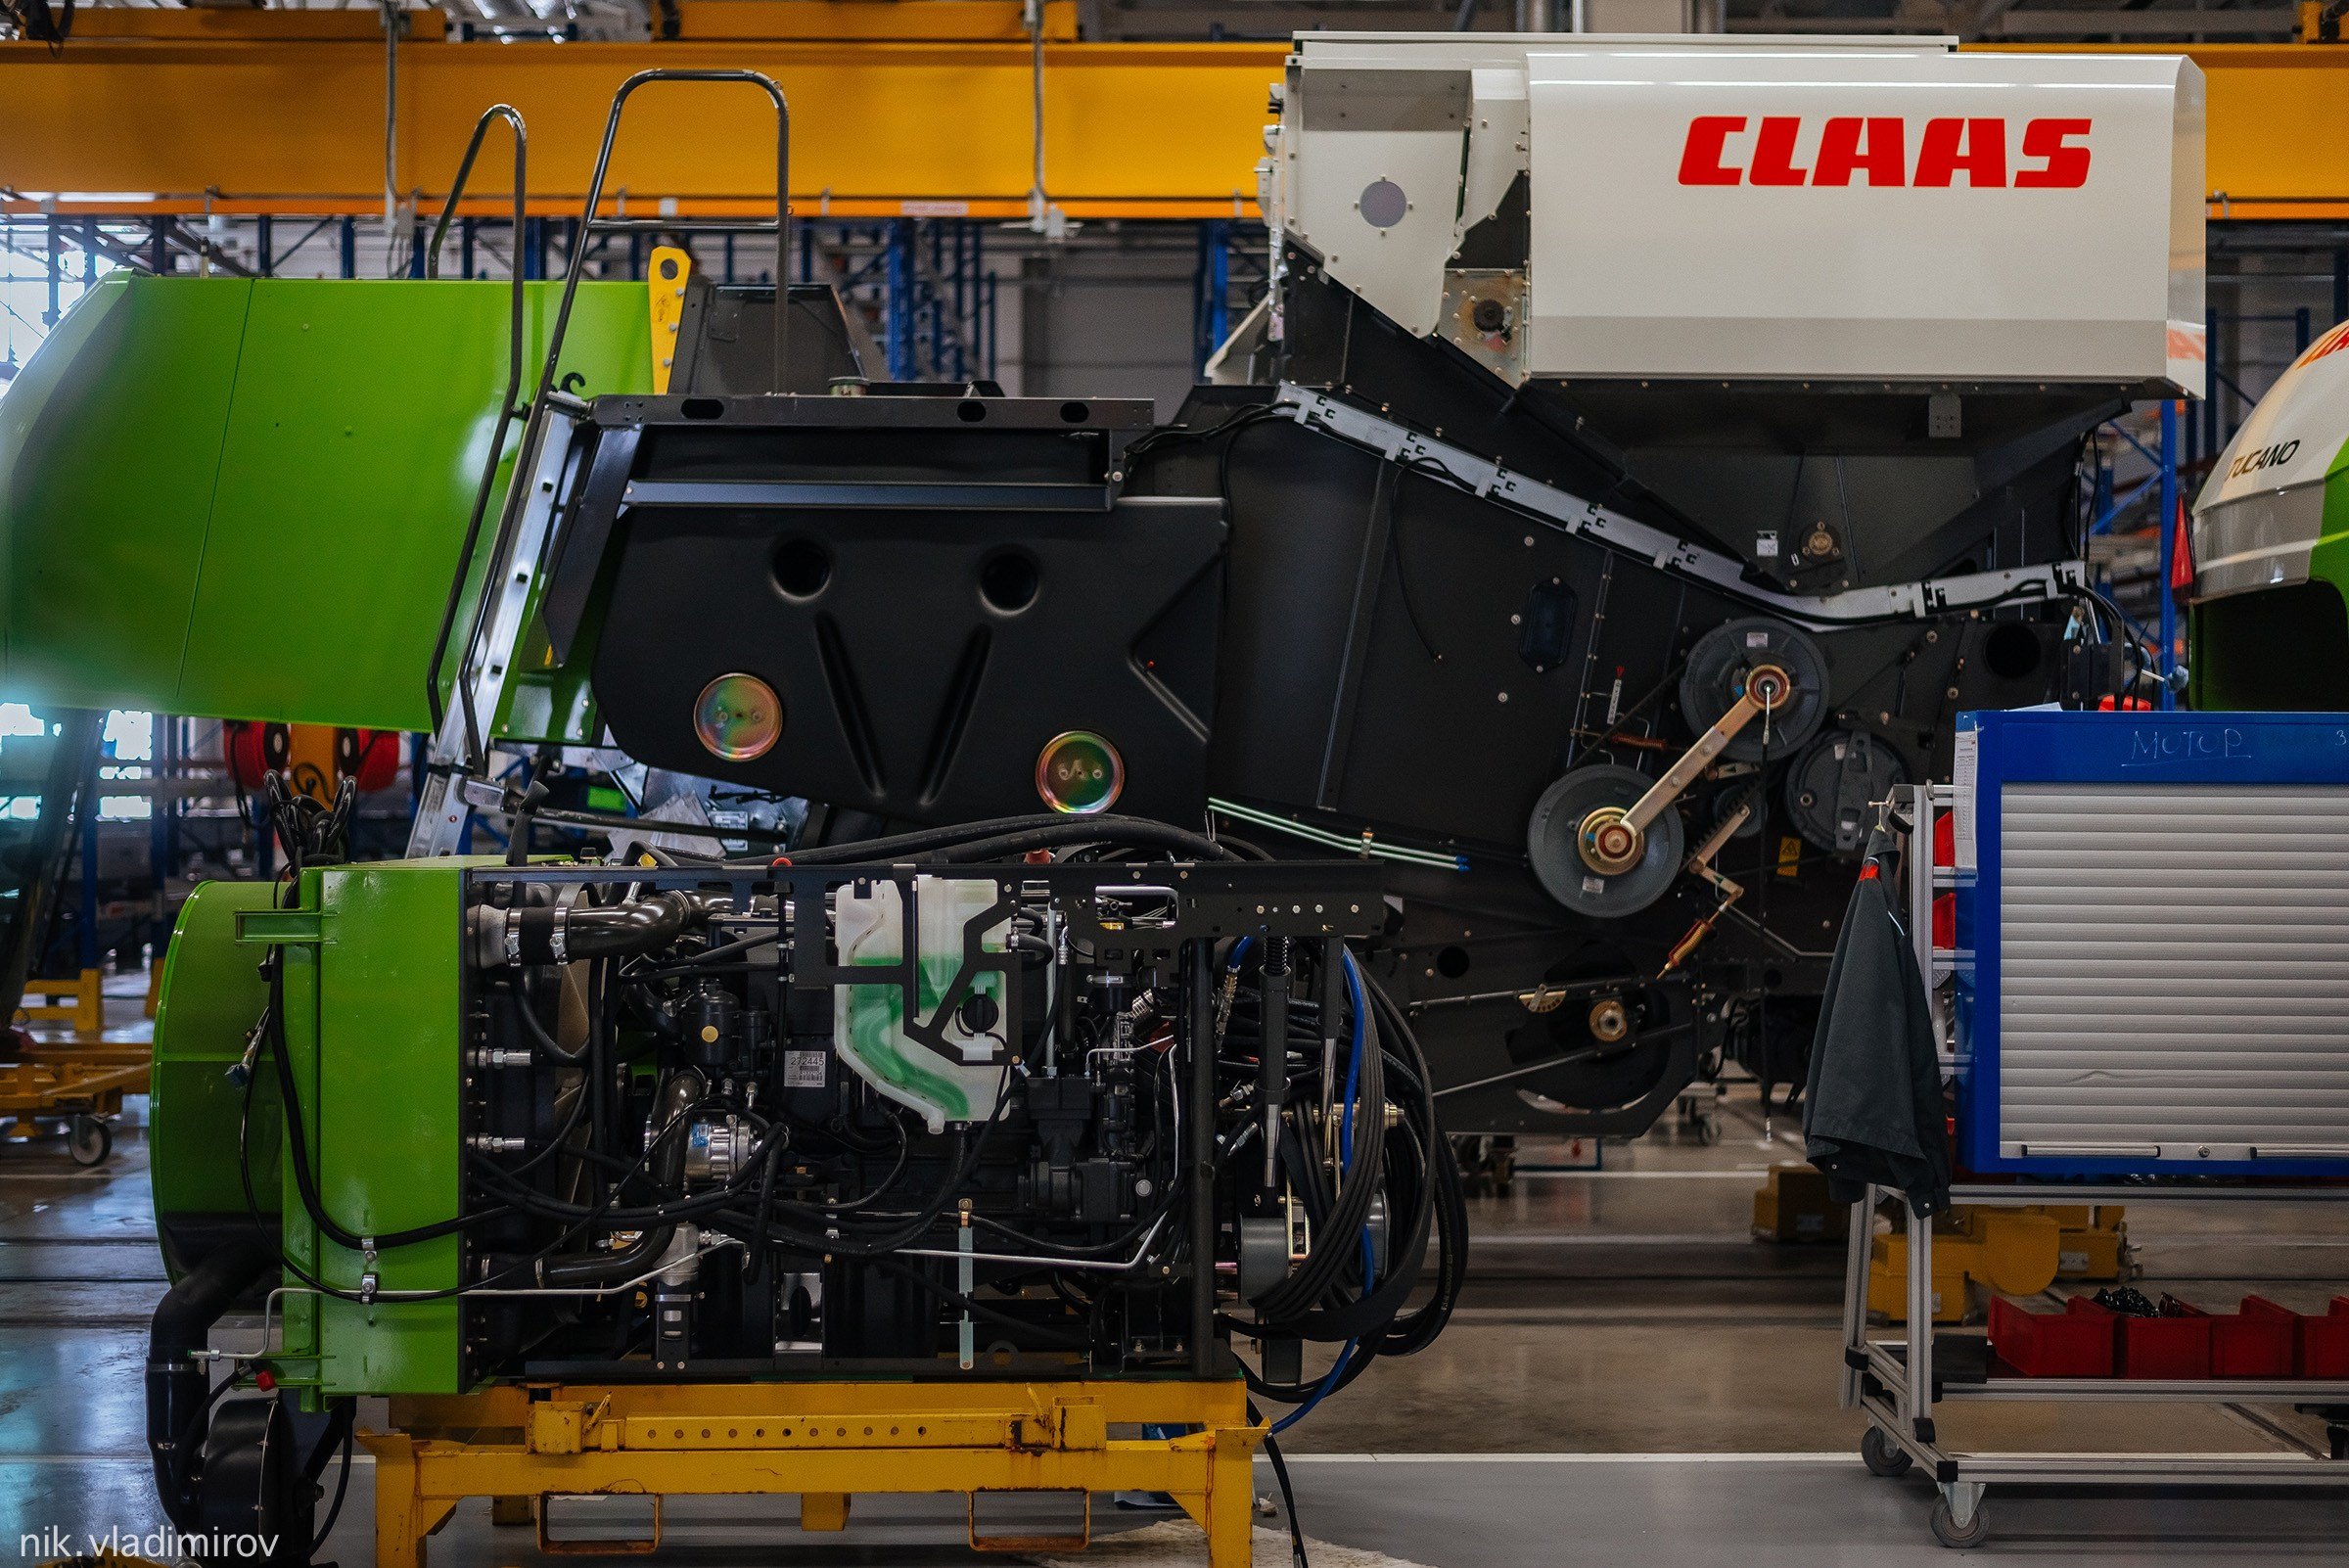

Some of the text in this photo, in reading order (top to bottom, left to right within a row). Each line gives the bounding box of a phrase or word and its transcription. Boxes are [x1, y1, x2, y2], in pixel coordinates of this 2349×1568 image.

[1678, 115, 2093, 188] CLAAS
[2225, 438, 2300, 482] TUCANO
[790, 1057, 824, 1066] 272445
